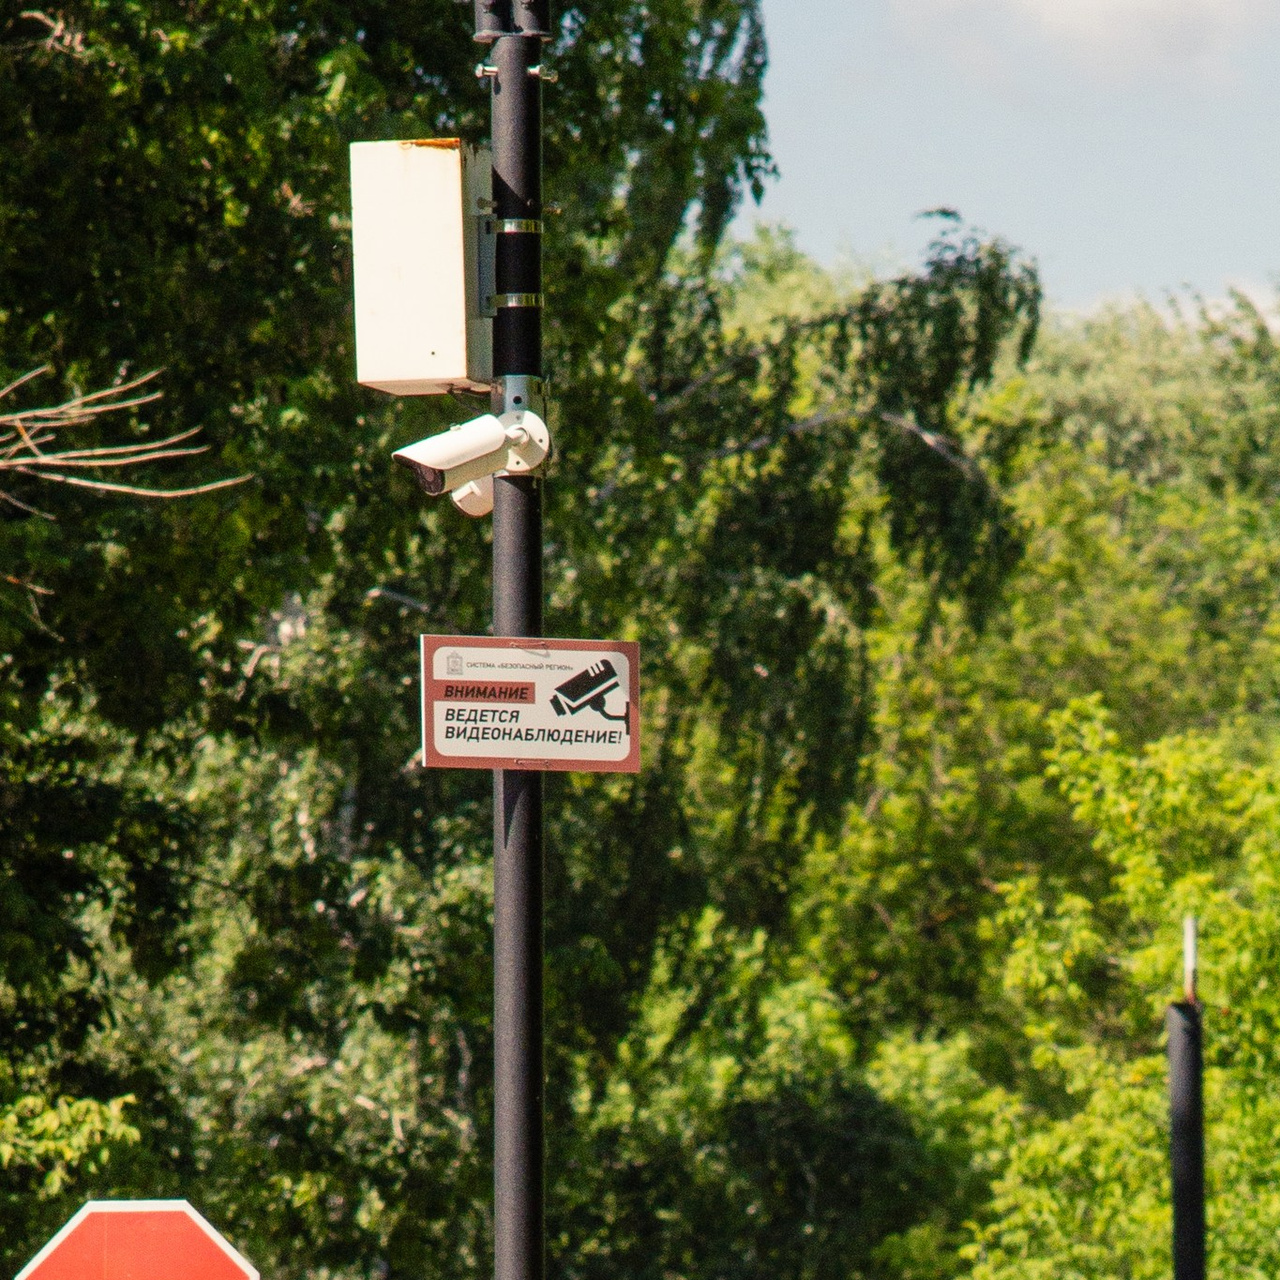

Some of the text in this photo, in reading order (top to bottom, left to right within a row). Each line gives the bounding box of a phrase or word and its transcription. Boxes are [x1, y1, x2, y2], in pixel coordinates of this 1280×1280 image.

[444, 685, 529, 700] ВНИМАНИЕ
[445, 708, 520, 724] ВЕДЕТСЯ
[445, 726, 623, 745] ВИДЕОНАБЛЮДЕНИЕ!
